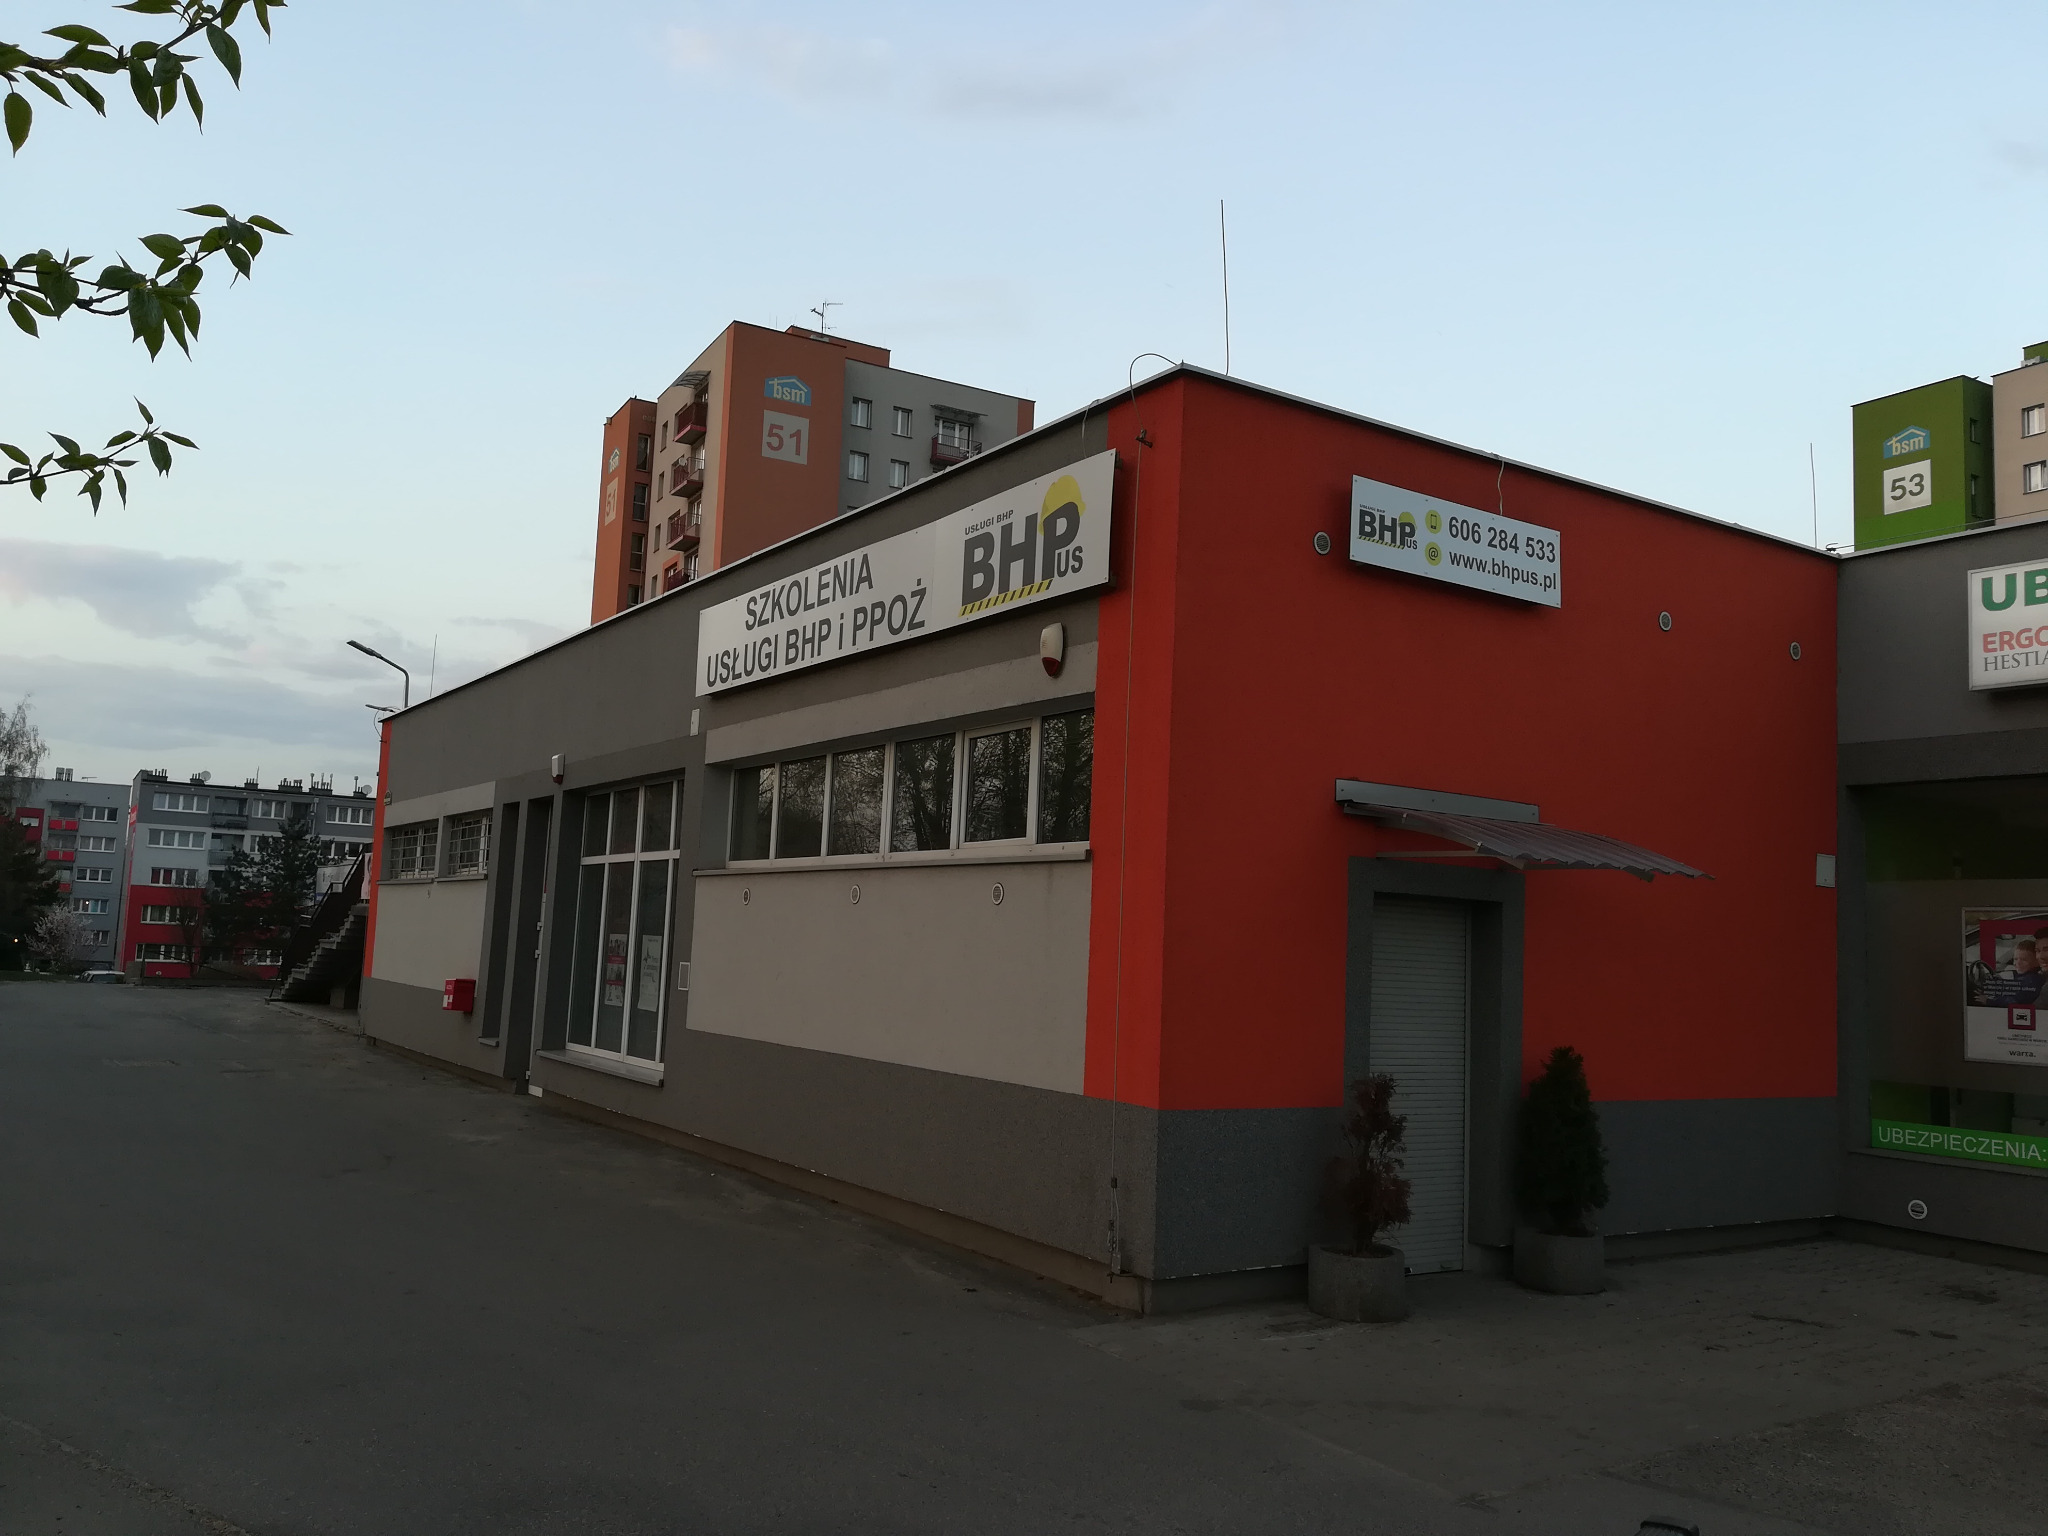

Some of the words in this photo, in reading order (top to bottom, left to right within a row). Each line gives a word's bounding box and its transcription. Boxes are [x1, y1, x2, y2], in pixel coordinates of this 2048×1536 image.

[773, 379, 806, 404] bsm
[766, 423, 802, 457] 51
[1891, 436, 1925, 456] bsm
[1890, 472, 1925, 502] 53
[964, 517, 994, 536] USŁUGI
[996, 509, 1014, 524] BHP
[1358, 508, 1416, 548] BHP
[1448, 516, 1482, 544] 606
[1487, 526, 1520, 554] 284
[1525, 536, 1556, 564] 533
[962, 501, 1081, 607] BHP
[1449, 551, 1557, 592] www.bhpus.pl
[745, 552, 874, 631] SZKOLENIA
[1981, 568, 2048, 611] UB
[707, 634, 779, 687] USŁUGI
[784, 618, 832, 666] BHP
[838, 612, 845, 650] i
[852, 577, 927, 647] PPOŻ
[1878, 1126, 2047, 1162] UBEZPIECZENIA:
